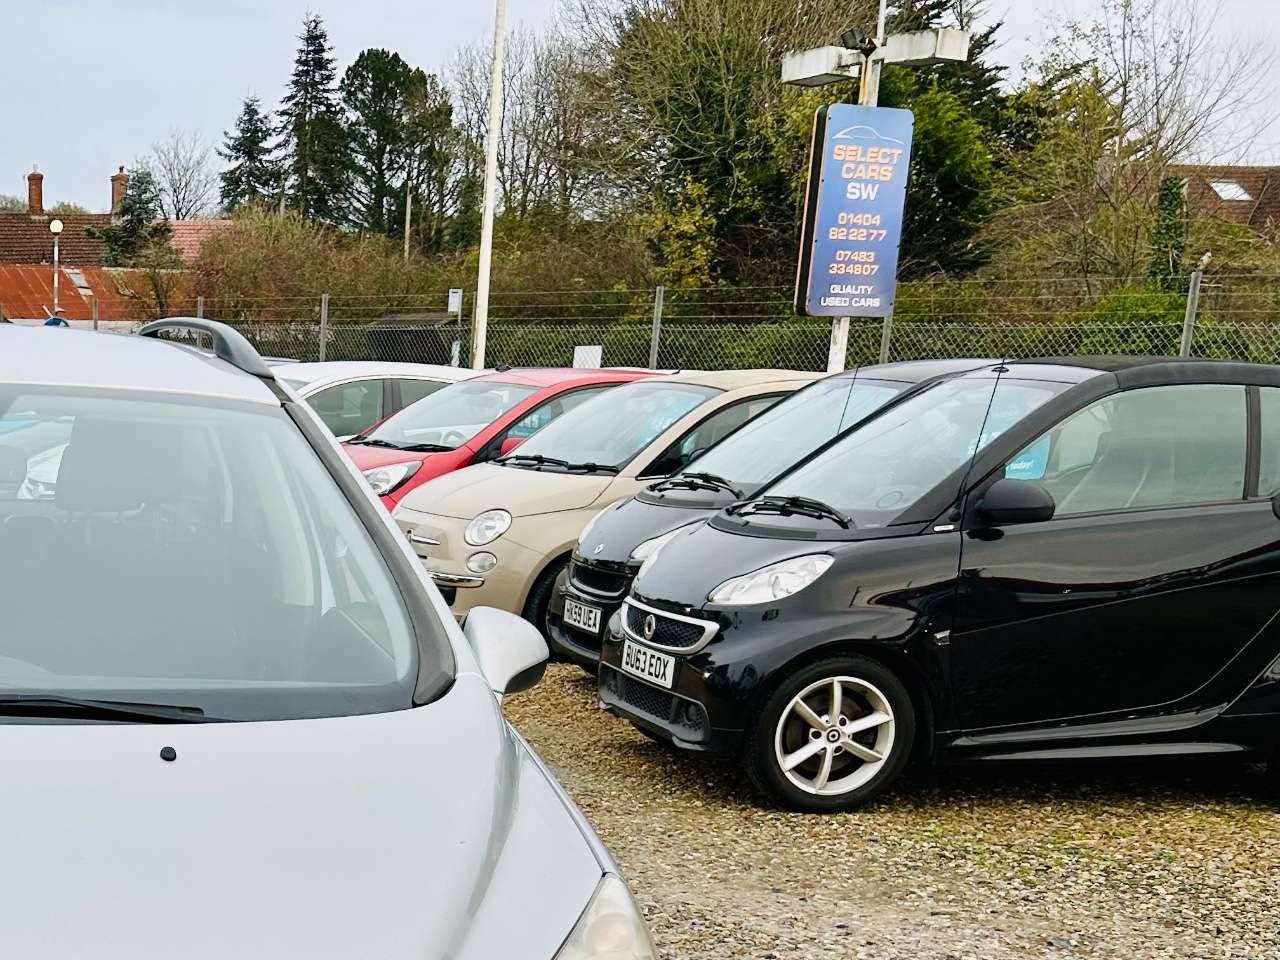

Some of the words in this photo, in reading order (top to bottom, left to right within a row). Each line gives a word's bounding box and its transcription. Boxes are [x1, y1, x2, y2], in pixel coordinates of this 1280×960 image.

[833, 145, 902, 163] SELECT
[841, 163, 893, 181] CARS
[846, 182, 879, 200] SW
[838, 212, 881, 226] 01404
[835, 250, 875, 262] 07483
[830, 284, 873, 294] QUALITY
[820, 296, 849, 306] USED
[851, 297, 881, 307] CARS
[582, 606, 598, 630] UEA
[625, 645, 647, 673] BU63
[648, 655, 669, 682] EOX
